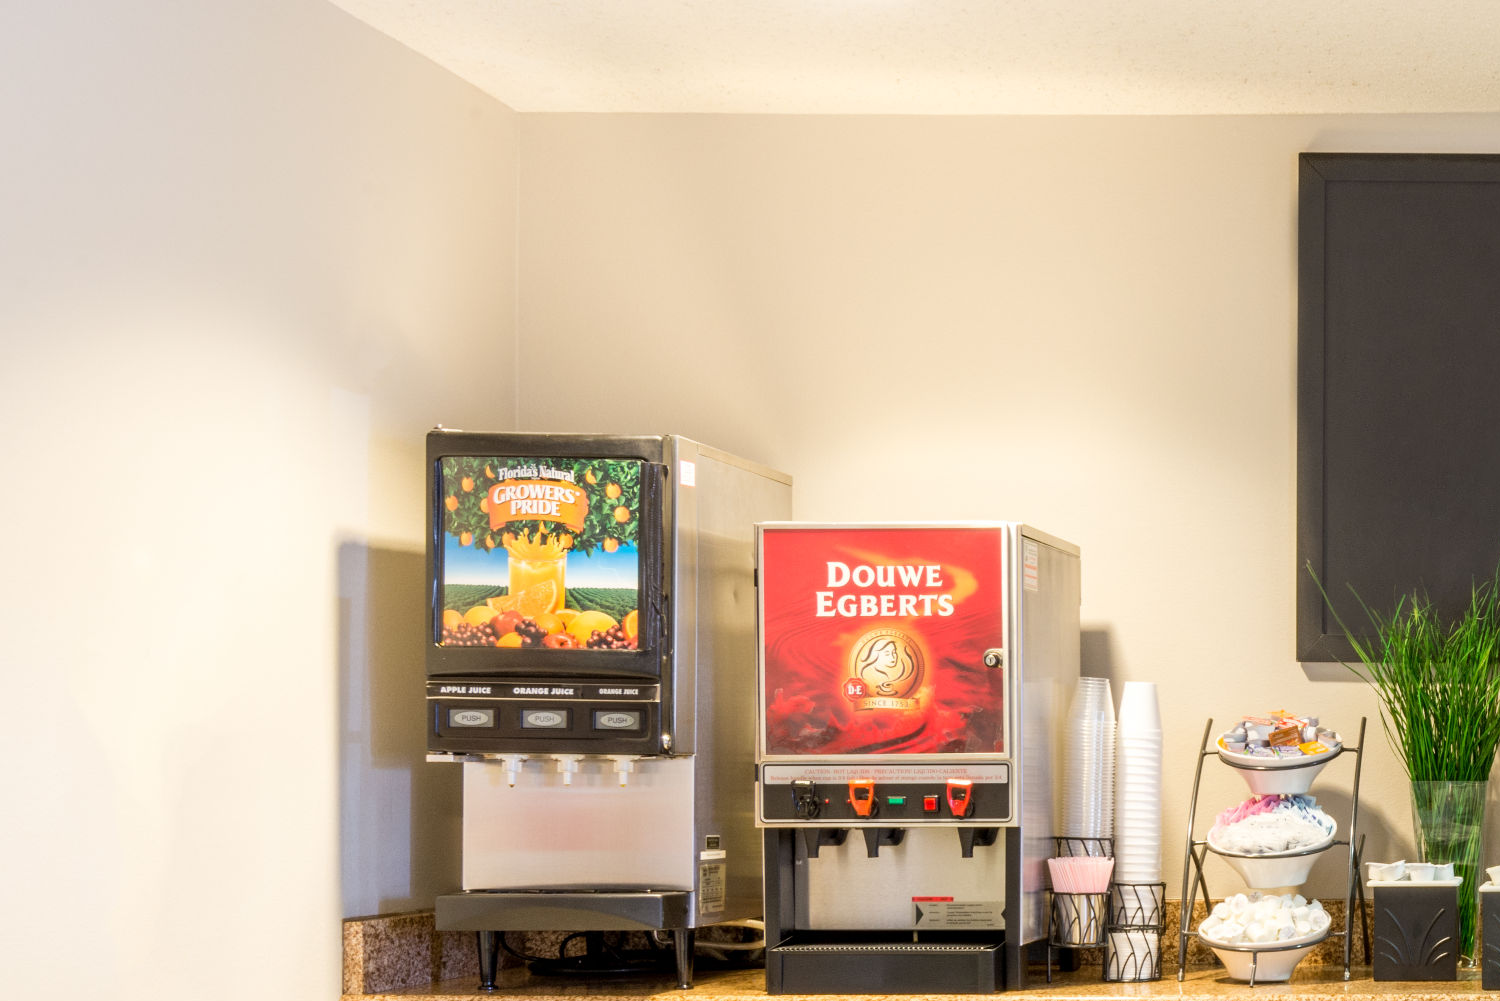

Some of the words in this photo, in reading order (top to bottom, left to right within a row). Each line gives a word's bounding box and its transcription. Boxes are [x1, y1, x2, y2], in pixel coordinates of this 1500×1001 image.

[498, 464, 538, 480] Florida's
[539, 466, 574, 482] Natural
[510, 499, 560, 517] PRIDE
[826, 561, 943, 588] DOUWE
[815, 591, 955, 618] EGBERTS
[440, 686, 466, 694] APPLE
[468, 686, 492, 694] JUICE
[513, 687, 549, 695] ORANGE
[461, 714, 481, 722] PUSH
[607, 716, 628, 724] PUSH
